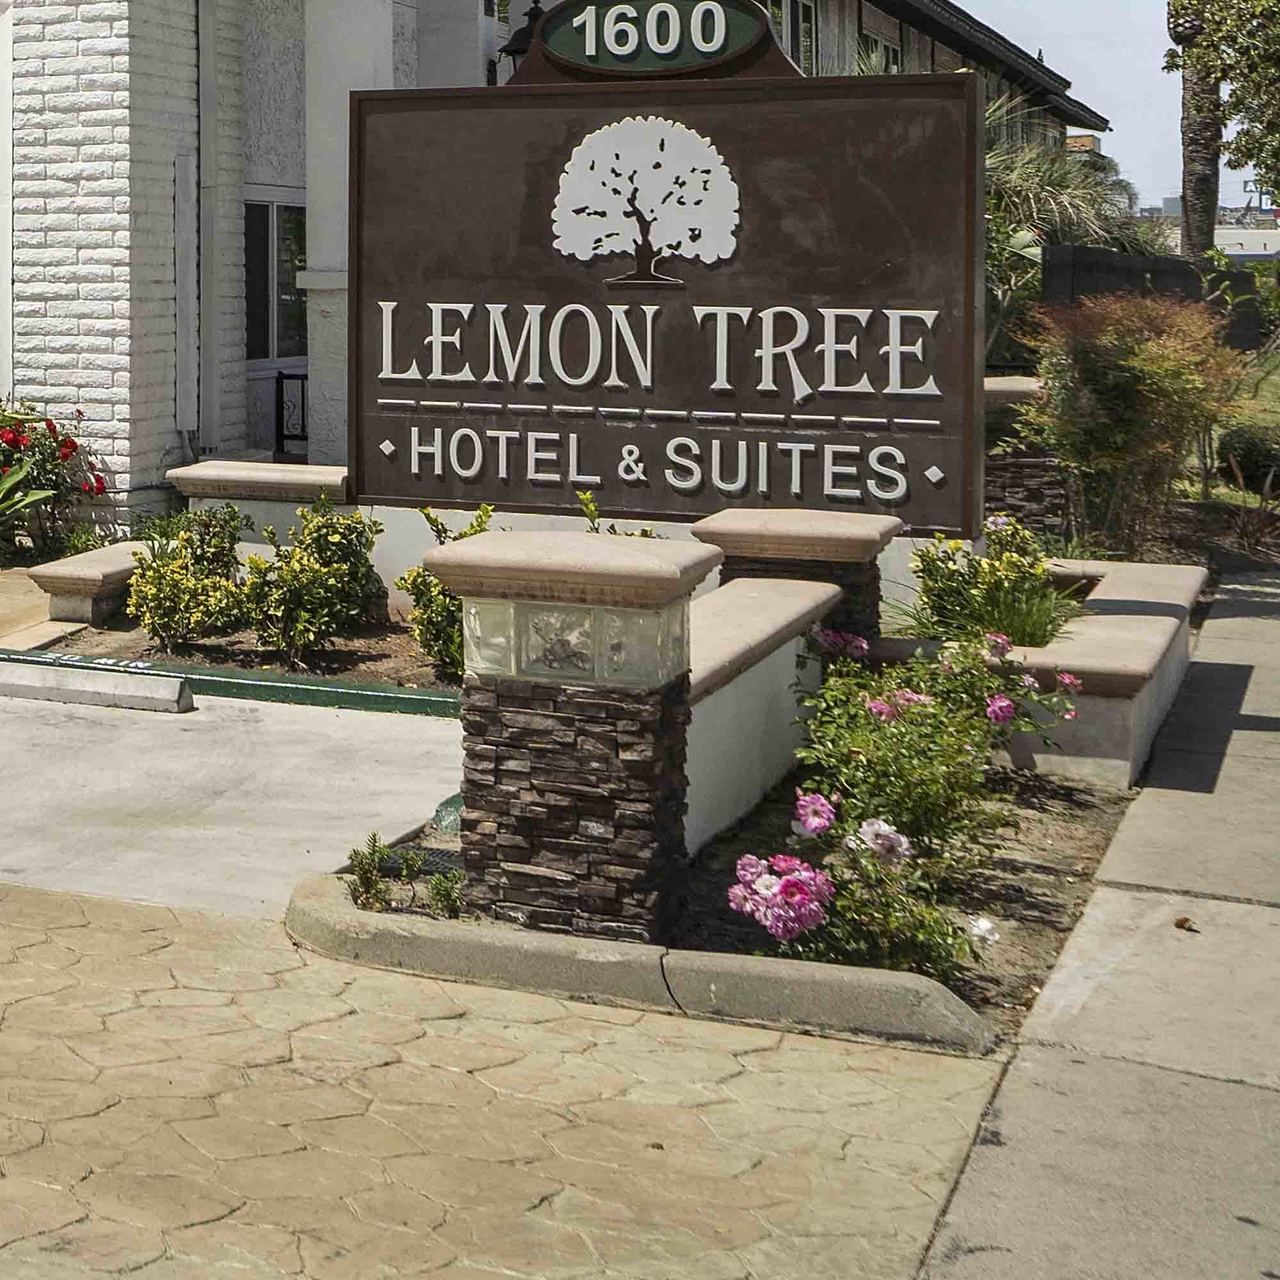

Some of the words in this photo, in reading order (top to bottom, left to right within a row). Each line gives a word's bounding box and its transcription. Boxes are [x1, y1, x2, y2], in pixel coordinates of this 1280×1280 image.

[572, 0, 727, 56] 1600
[377, 301, 660, 391] LEMON
[692, 305, 943, 405] TREE
[409, 426, 602, 486] HOTEL
[617, 443, 648, 483] &
[664, 435, 909, 502] SUITES
